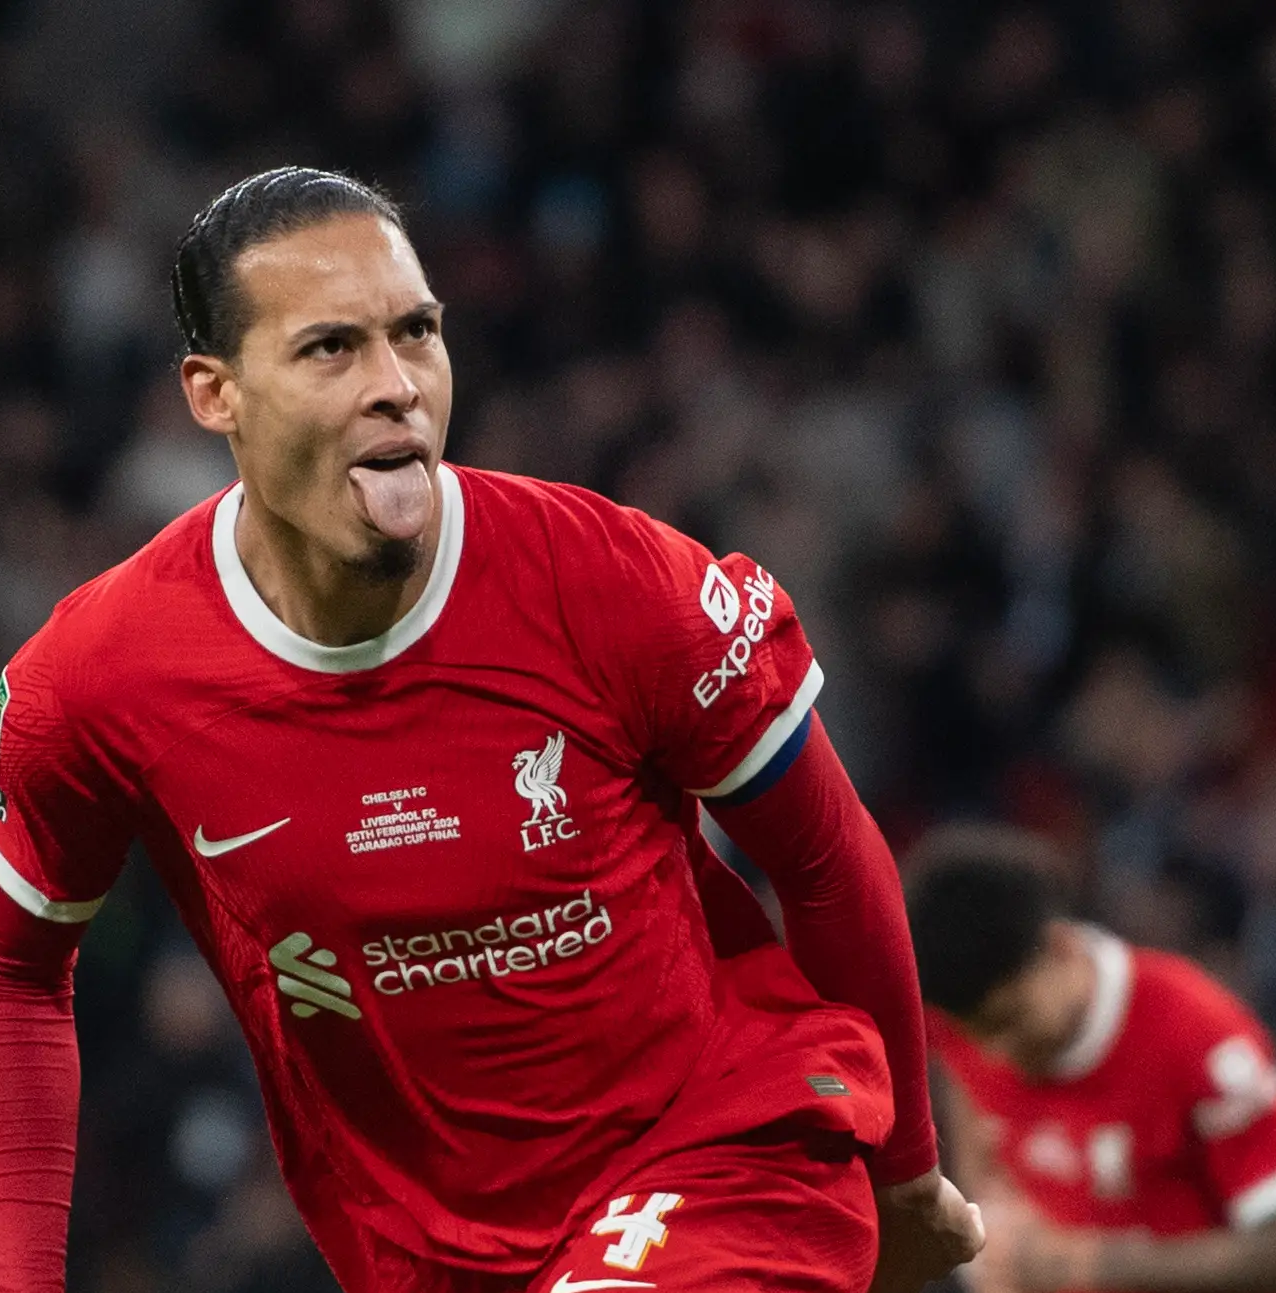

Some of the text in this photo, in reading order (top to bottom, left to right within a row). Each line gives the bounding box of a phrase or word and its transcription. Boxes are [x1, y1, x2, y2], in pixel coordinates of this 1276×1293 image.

[361, 786, 427, 805] CHELSEA FC
[392, 801, 402, 812] V
[345, 816, 460, 843] 25TH FEBRUARY 2024
[360, 808, 437, 829] LIVERPOOL FC
[349, 828, 461, 854] CARABAO CUP FINAL
[362, 887, 593, 967] standard
[373, 905, 613, 996] chartered
[590, 1191, 685, 1272] 4
